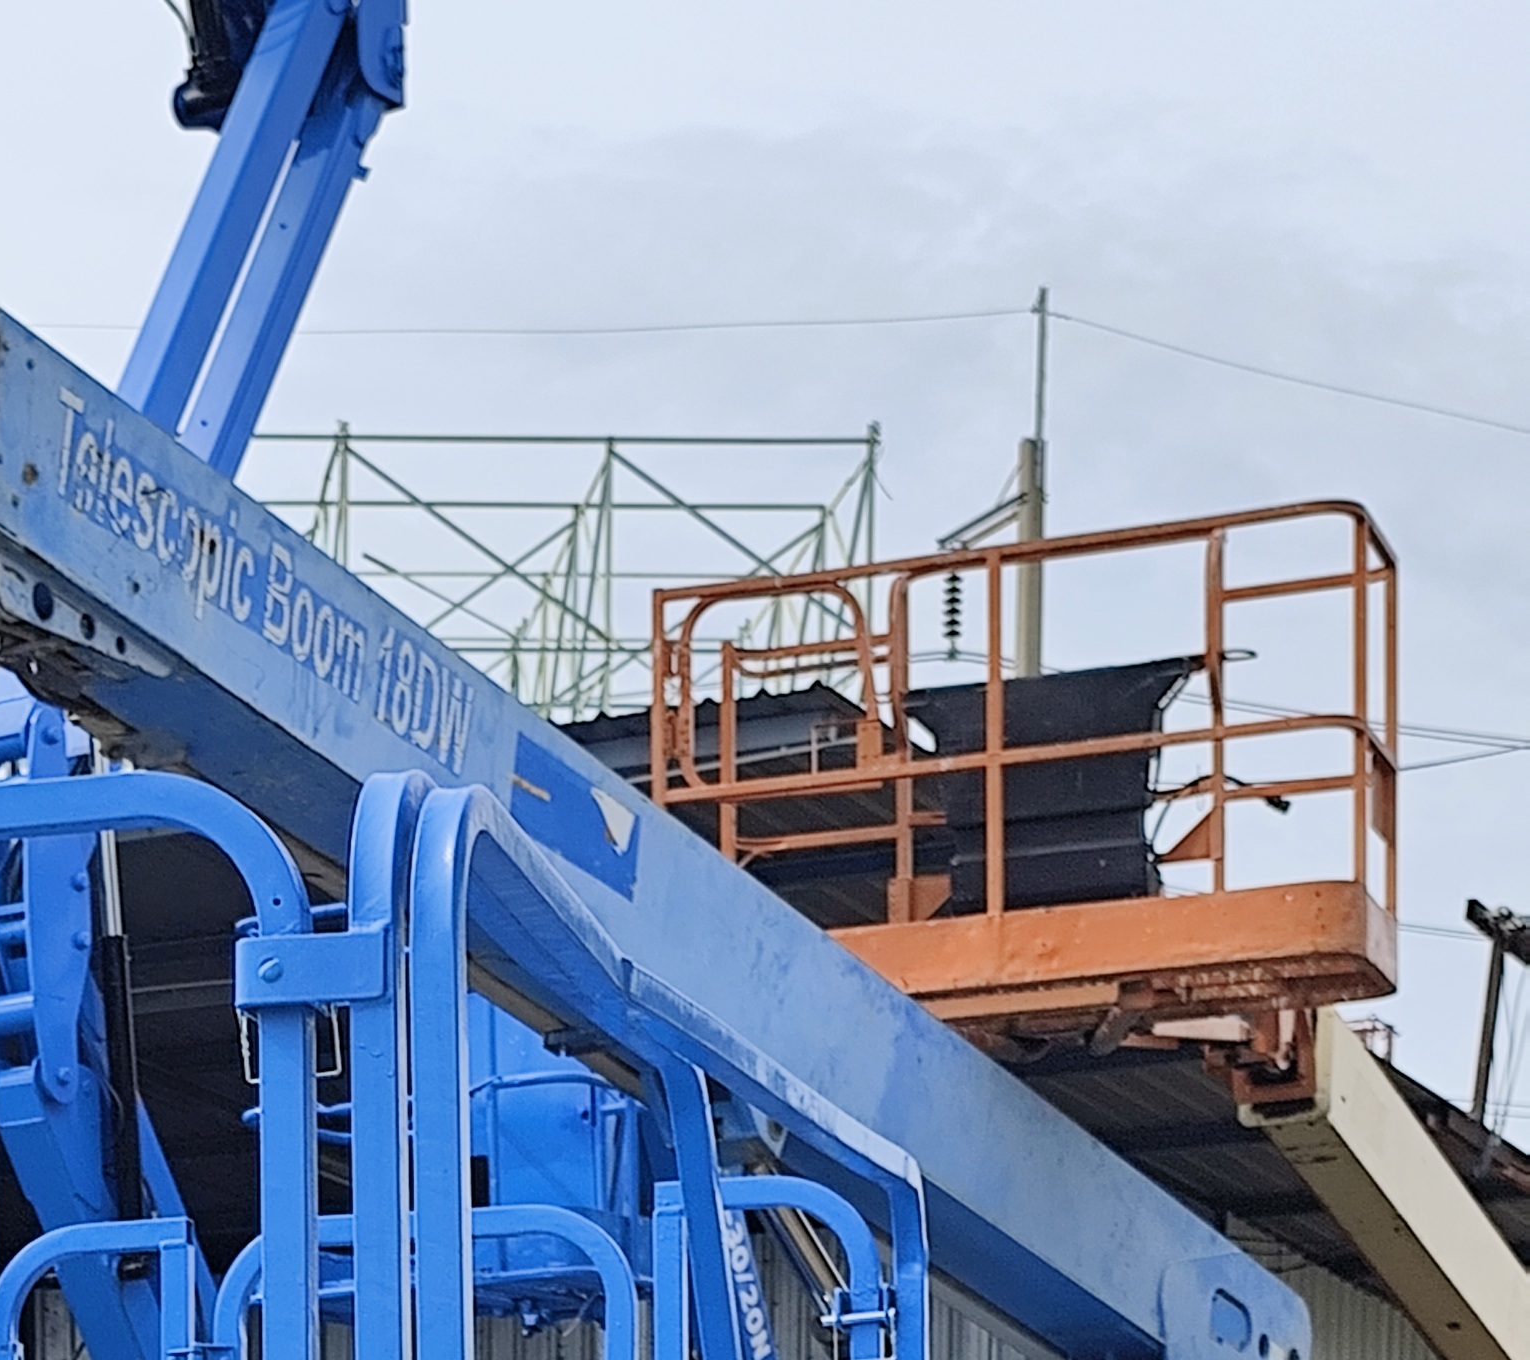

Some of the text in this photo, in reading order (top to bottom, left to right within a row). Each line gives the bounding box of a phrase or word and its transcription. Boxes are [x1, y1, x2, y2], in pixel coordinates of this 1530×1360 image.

[58, 386, 475, 776] Telescopic Boom 18DW
